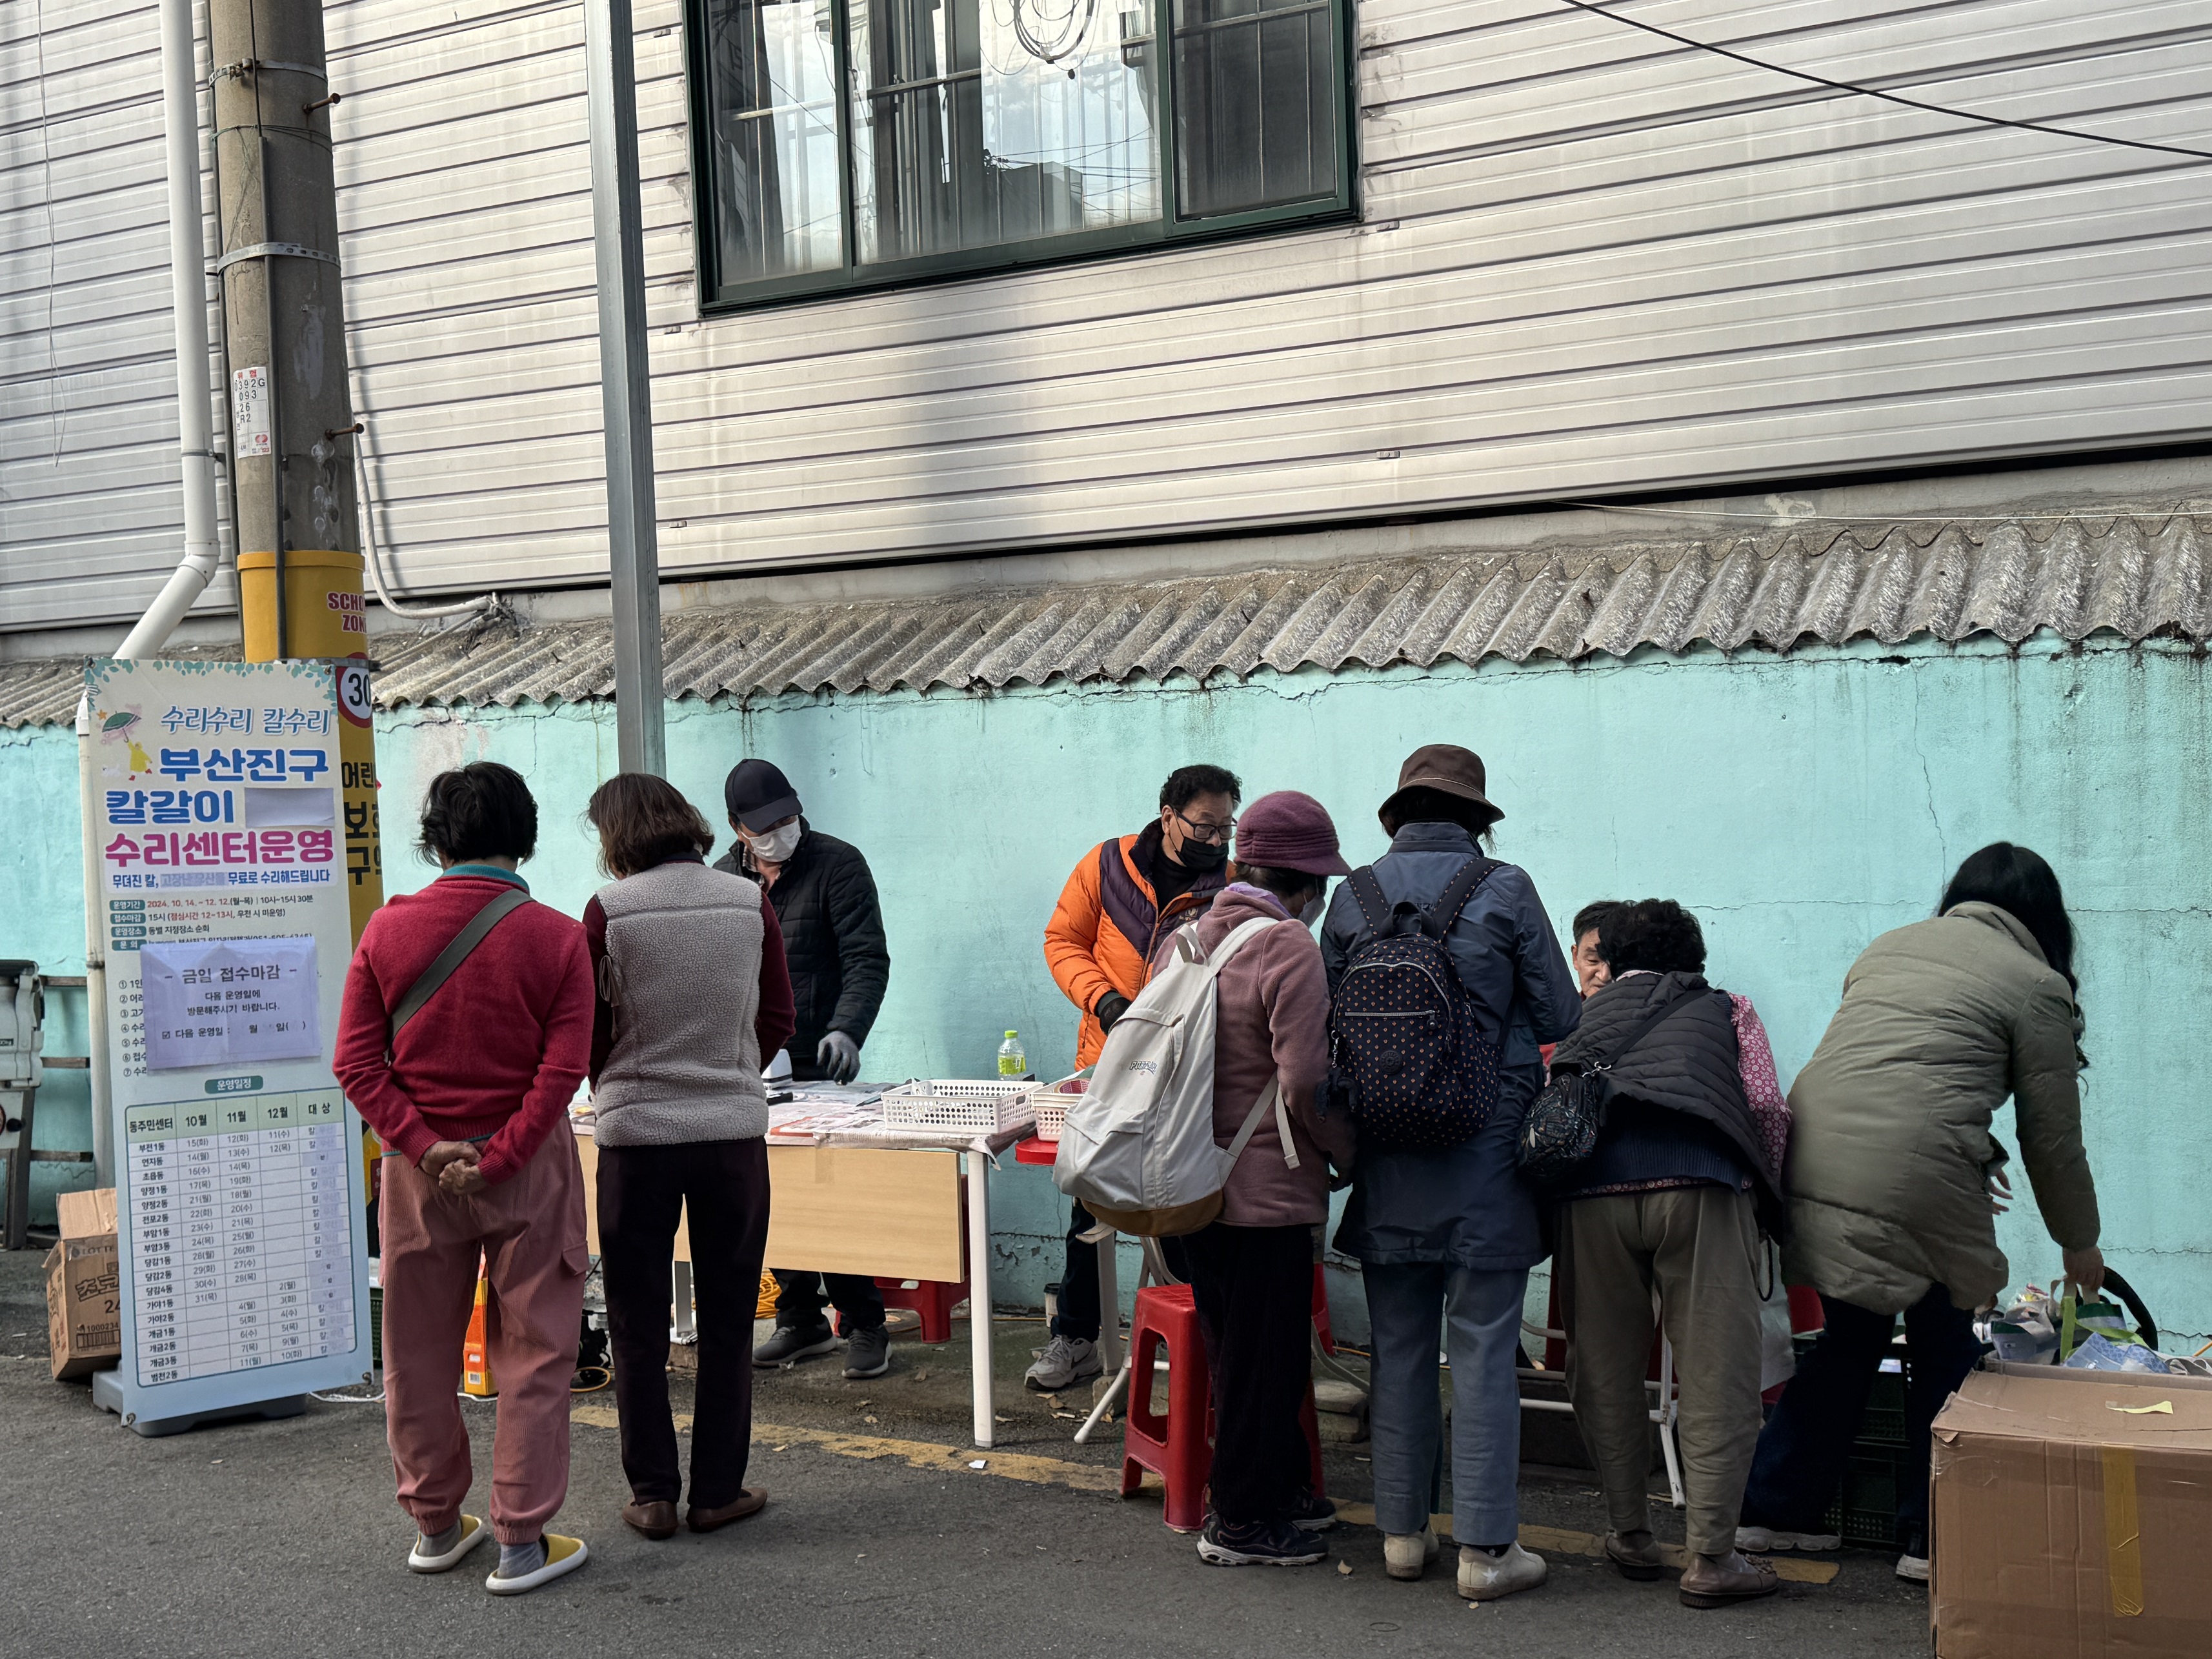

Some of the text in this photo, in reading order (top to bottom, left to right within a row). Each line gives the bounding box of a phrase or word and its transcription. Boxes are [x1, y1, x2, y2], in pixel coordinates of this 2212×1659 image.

[239, 390, 257, 401] 093
[239, 402, 250, 413] 26
[327, 592, 365, 613] SCHO
[348, 673, 372, 708] 30
[161, 705, 329, 735] 수리수리 칼수리
[159, 748, 329, 782] 부산진구
[106, 789, 234, 824] 칼갈이
[105, 829, 334, 867] 수리센터운영
[113, 874, 143, 889] 무뎌진
[145, 874, 159, 889] 칼,
[228, 870, 259, 885] 무료로
[261, 869, 330, 884] 수리해드립니다
[113, 901, 141, 910] 운영기간
[114, 914, 141, 923] 접수마감
[148, 913, 166, 921] 15시
[167, 912, 199, 922] (점심시간
[253, 909, 261, 918] 시
[262, 908, 286, 918] 미운영)
[115, 927, 143, 936] 운영장소
[148, 924, 210, 935] 동별 지정장소 순회
[130, 940, 138, 949] 의
[182, 964, 281, 985] 금일 접수마감
[205, 989, 261, 1001] 다음 운영일에
[187, 1001, 281, 1016] 방문해주시기 바랍니다.
[175, 1029, 194, 1039] 다음
[198, 1027, 223, 1038] 운영일
[249, 1024, 258, 1034] 월
[216, 1078, 252, 1091] 운영일정
[129, 1102, 331, 1133] 동주민센터 10월 11월 12월 대 상
[139, 1142, 165, 1152] 부전1동
[141, 1157, 163, 1167] 연지동
[141, 1185, 168, 1196] 양정1동
[141, 1199, 168, 1211] 양정2동
[142, 1213, 169, 1225] 전포2동
[143, 1227, 170, 1239] 부암1동
[82, 1245, 116, 1255] LOTTE
[143, 1242, 170, 1253] 부암3동
[145, 1256, 171, 1267] 당감1동
[145, 1270, 172, 1282] 당감2동
[146, 1284, 173, 1296] 당감4동
[146, 1298, 174, 1310] 가야1동
[148, 1312, 175, 1325] 가야2동
[148, 1327, 176, 1339] 개금1동
[149, 1341, 176, 1353] 개금2동
[150, 1356, 177, 1368] 개금3동
[151, 1370, 178, 1383] 범천2동
